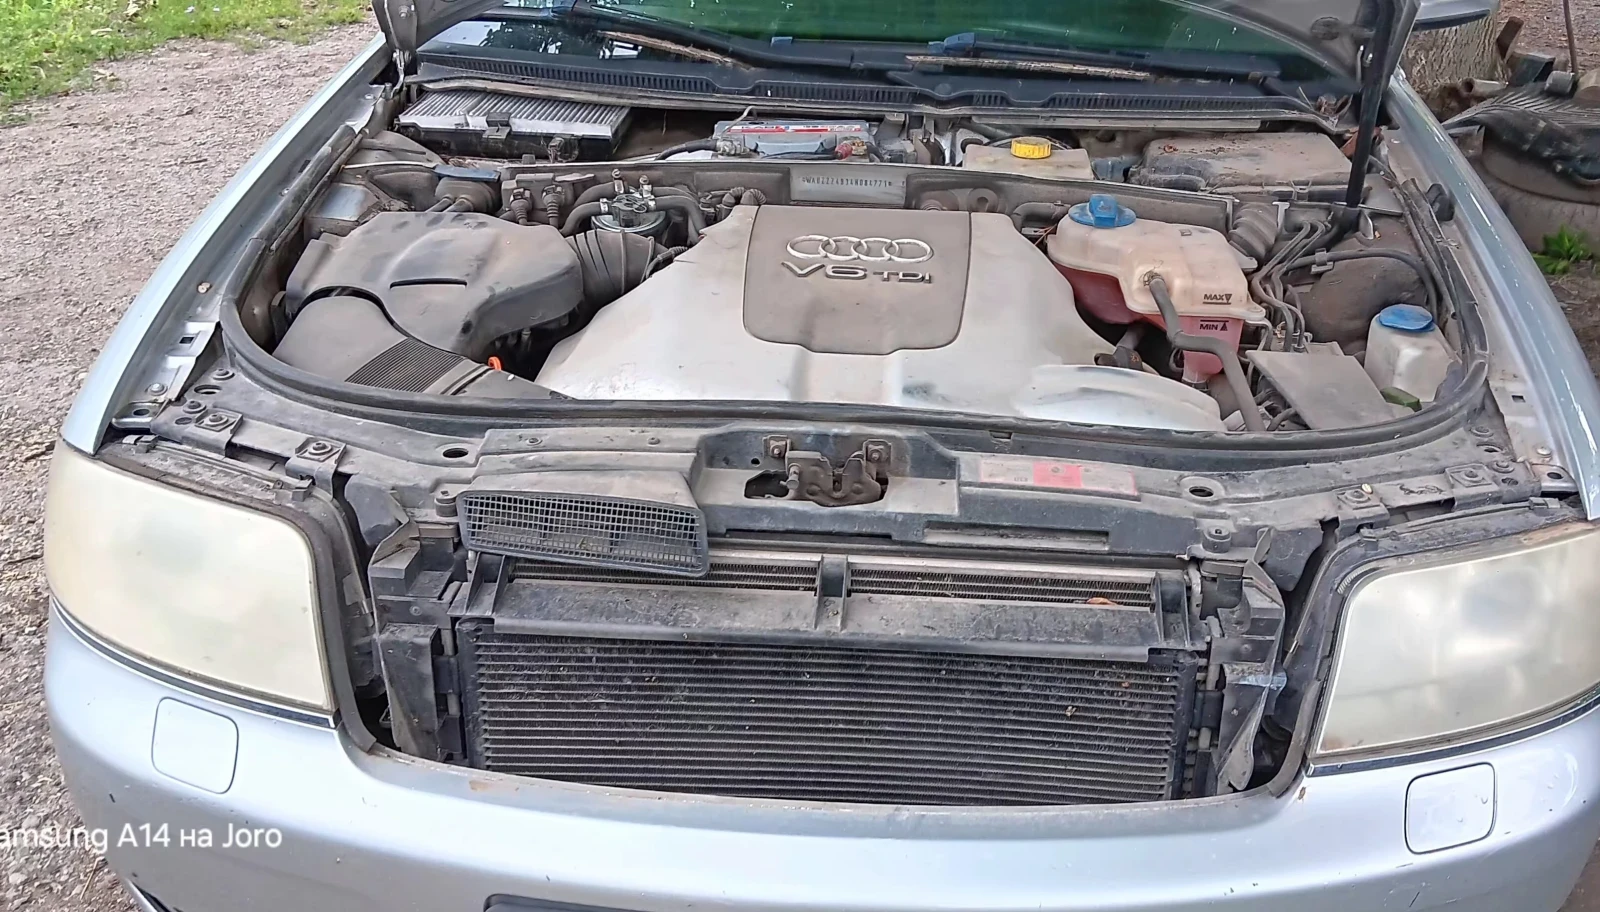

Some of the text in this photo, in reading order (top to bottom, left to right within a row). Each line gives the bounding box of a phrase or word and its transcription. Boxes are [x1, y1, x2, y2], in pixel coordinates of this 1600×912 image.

[781, 261, 932, 283] V6 TDI
[1203, 293, 1225, 301] MAX
[1199, 323, 1219, 331] MIN
